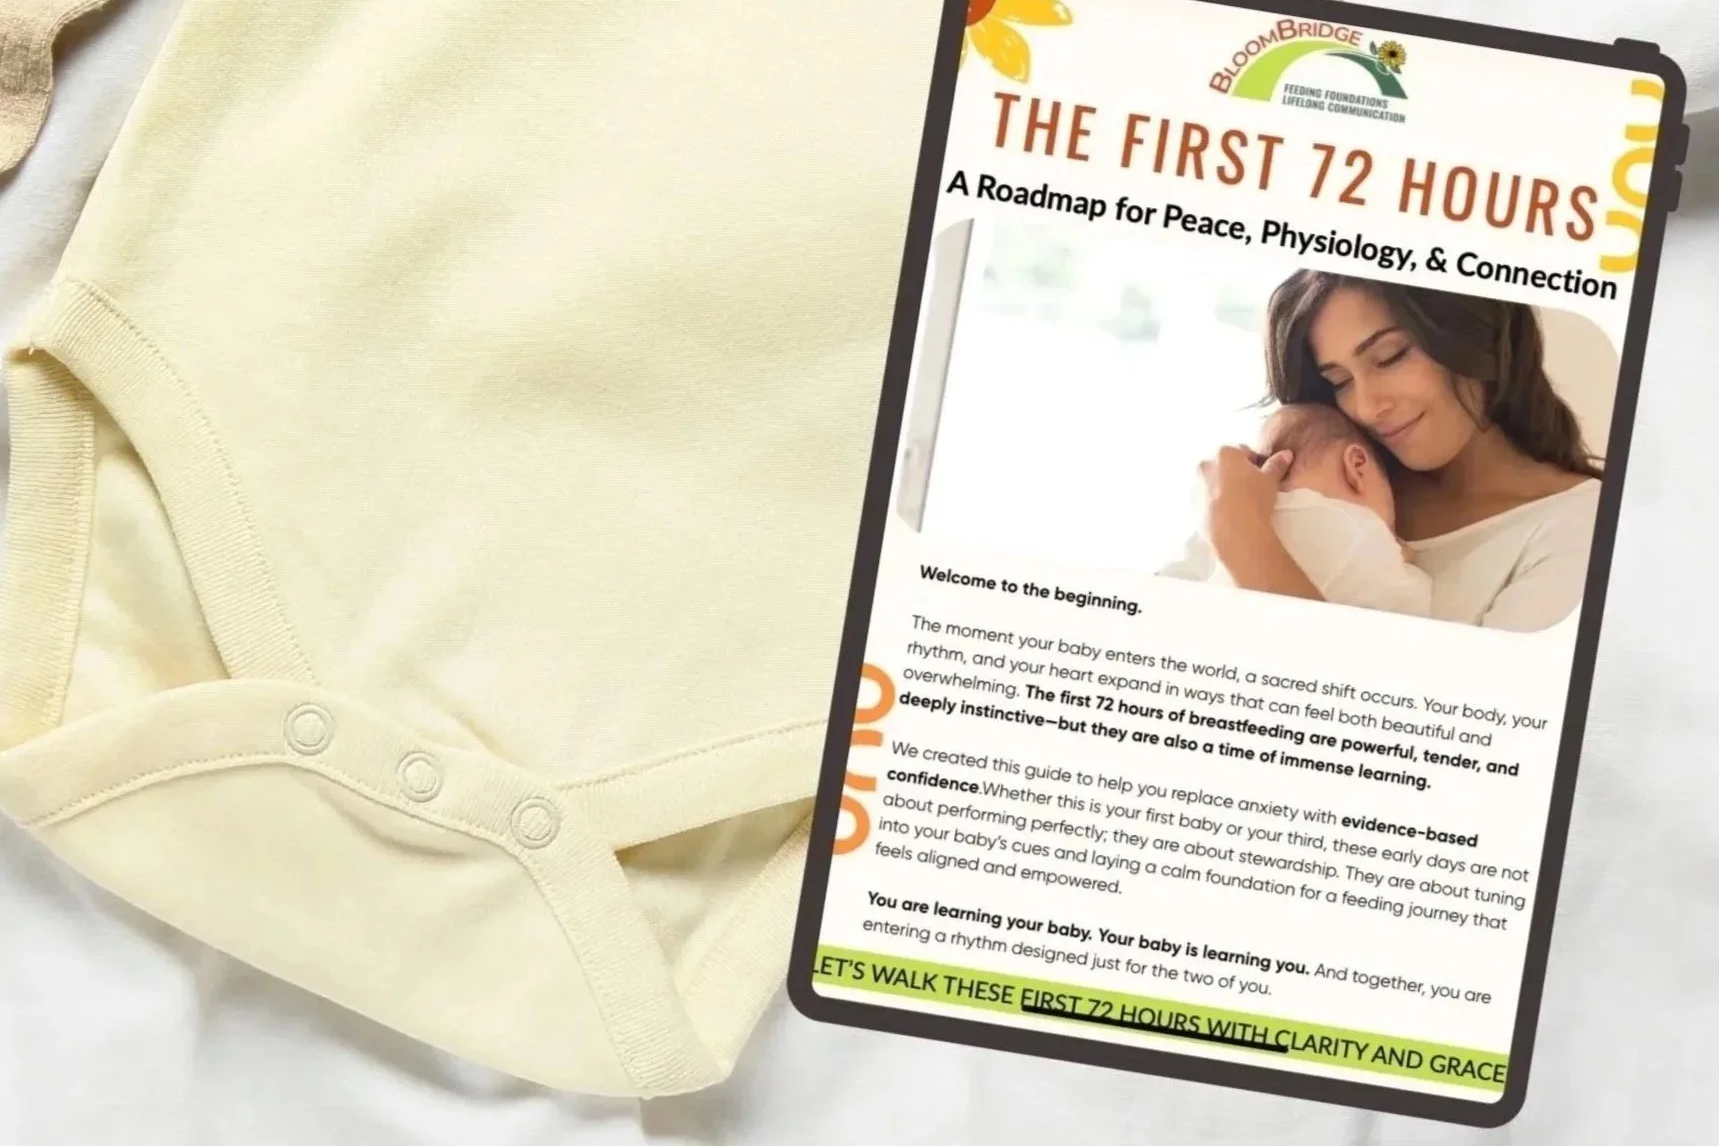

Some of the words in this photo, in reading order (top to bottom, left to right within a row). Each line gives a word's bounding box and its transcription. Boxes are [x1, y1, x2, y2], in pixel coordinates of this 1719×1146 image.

[1282, 95, 1326, 112] LIFELONG
[1327, 102, 1406, 124] COMMUNICATION
[1284, 84, 1322, 100] FEEDING
[1324, 90, 1389, 110] FOUNDATIONS
[995, 92, 1096, 161] THE
[1121, 113, 1284, 190] FIRST
[1310, 143, 1372, 205] 72
[1399, 158, 1597, 241] HOURS
[945, 170, 969, 196] A
[976, 173, 1107, 222] Roadmap
[1115, 196, 1157, 225] for
[1162, 203, 1252, 245] Peace,
[1261, 219, 1417, 272] Physiology,
[1425, 246, 1447, 273] &
[1456, 251, 1617, 300] Connection
[920, 564, 997, 590] Welcome
[1001, 579, 1018, 593] to
[1022, 582, 1050, 598] the
[1054, 586, 1142, 616] beginning.
[903, 668, 1019, 699] overwhelming.
[1025, 684, 1056, 702] The
[1060, 689, 1091, 708] first
[1096, 695, 1114, 712] 72
[1118, 699, 1164, 720] hours
[1168, 709, 1186, 723] of
[1188, 710, 1305, 746] breastfeeding
[1309, 733, 1337, 747] are
[1340, 738, 1418, 763] powerful,
[1423, 749, 1481, 773] tender,
[1486, 762, 1520, 777] and
[907, 641, 966, 665] rhythm,
[972, 654, 1005, 668] and
[1009, 660, 1045, 674] your
[1049, 663, 1093, 683] heart
[1097, 674, 1162, 693] expand
[1165, 685, 1179, 696] in
[1184, 688, 1224, 705] ways
[1230, 693, 1265, 710] that
[1268, 701, 1300, 715] can
[1305, 703, 1335, 721] feel
[1338, 710, 1377, 728] both
[1381, 716, 1455, 740] beautiful
[1459, 732, 1492, 746] and
[912, 614, 941, 633] The
[945, 624, 1014, 644] moment
[1018, 636, 1054, 650] your
[1058, 639, 1101, 661] baby
[1105, 649, 1155, 667] enters
[1161, 656, 1187, 672] the
[1192, 664, 1239, 683] world,
[1245, 672, 1257, 683] a
[1261, 675, 1318, 693] sacred
[1321, 683, 1356, 699] shift
[1360, 691, 1417, 709] occurs.
[1423, 697, 1459, 715] Your
[1462, 703, 1506, 726] body,
[1512, 715, 1548, 729] your
[892, 741, 919, 758] We
[922, 749, 988, 769] created
[992, 758, 1020, 774] this
[1024, 765, 1072, 782] guide
[1076, 772, 1093, 786] to
[1097, 774, 1133, 794] help
[1137, 783, 1167, 798] you
[1171, 789, 1234, 808] replace
[1238, 800, 1299, 821] anxiety
[1303, 809, 1337, 825] with
[1341, 816, 1479, 848] evidence-based
[899, 691, 957, 715] deeply
[1091, 722, 1128, 743] they
[1131, 731, 1160, 745] are
[1163, 734, 1198, 751] also
[1202, 742, 1214, 754] a
[1218, 742, 1255, 760] time
[1259, 749, 1278, 764] of
[1280, 751, 1354, 776] immense
[1358, 763, 1431, 791] learning.
[875, 841, 912, 860] feels
[917, 849, 980, 871] aligned
[983, 862, 1017, 877] and
[1020, 868, 1121, 894] empowered.
[879, 820, 910, 834] into
[914, 825, 950, 840] your
[1011, 841, 1050, 857] cues
[1054, 848, 1088, 863] and
[1091, 850, 1141, 875] laying
[1145, 863, 1157, 874] a
[1161, 865, 1201, 881] calm
[1206, 869, 1295, 896] foundation
[1300, 884, 1322, 900] for
[1325, 891, 1337, 903] a
[1342, 890, 1404, 917] feeding
[1407, 902, 1469, 927] journey
[1473, 913, 1508, 930] that
[882, 794, 933, 813] about
[937, 804, 1027, 831] performing
[1030, 819, 1108, 842] perfectly;
[1113, 829, 1148, 849] they
[1152, 838, 1180, 852] are
[1184, 842, 1235, 861] about
[1239, 851, 1339, 879] stewardship.
[1346, 865, 1384, 887] They
[1388, 876, 1415, 890] are
[1419, 880, 1470, 899] about
[1475, 888, 1526, 911] tuning
[1057, 794, 1085, 811] this
[1089, 798, 1101, 814] is
[1106, 805, 1141, 819] your
[1146, 808, 1175, 825] first
[1178, 813, 1223, 835] baby
[1226, 824, 1243, 835] or
[1247, 827, 1283, 842] your
[1288, 831, 1327, 852] third,
[1333, 839, 1377, 858] these
[1381, 849, 1423, 867] early
[1426, 854, 1465, 873] days
[1470, 863, 1497, 877] are
[1501, 868, 1529, 882] not
[862, 920, 931, 944] entering
[934, 931, 946, 943] a
[950, 931, 1007, 952] rhythm
[1011, 942, 1089, 965] designed
[1090, 957, 1121, 971] just
[1126, 959, 1147, 975] for
[1152, 964, 1179, 980] the
[1184, 970, 1214, 986] two
[1218, 975, 1236, 988] of
[1239, 980, 1271, 995] you.
[868, 890, 898, 909] You
[901, 900, 929, 914] are
[933, 901, 1002, 929] learning
[1006, 916, 1044, 932] your
[1047, 919, 1092, 942] baby.
[1099, 928, 1135, 947] Your
[1138, 934, 1182, 958] baby
[1185, 942, 1198, 957] is
[1202, 944, 1272, 972] learning
[1275, 959, 1310, 975] you.
[1314, 963, 1348, 981] And
[1353, 970, 1425, 996] together,
[1431, 985, 1460, 999] you
[1464, 990, 1492, 1004] are
[871, 963, 938, 992] WALK
[943, 975, 1015, 1004] THESE
[1020, 988, 1082, 1017] FIRST
[1085, 998, 1113, 1022] 72
[1119, 1004, 1200, 1035] HOURS
[1205, 1017, 1268, 1046] WITH
[1273, 1029, 1369, 1060] CLARITY
[1370, 1045, 1423, 1069] AND
[1429, 1054, 1507, 1083] GRACE
